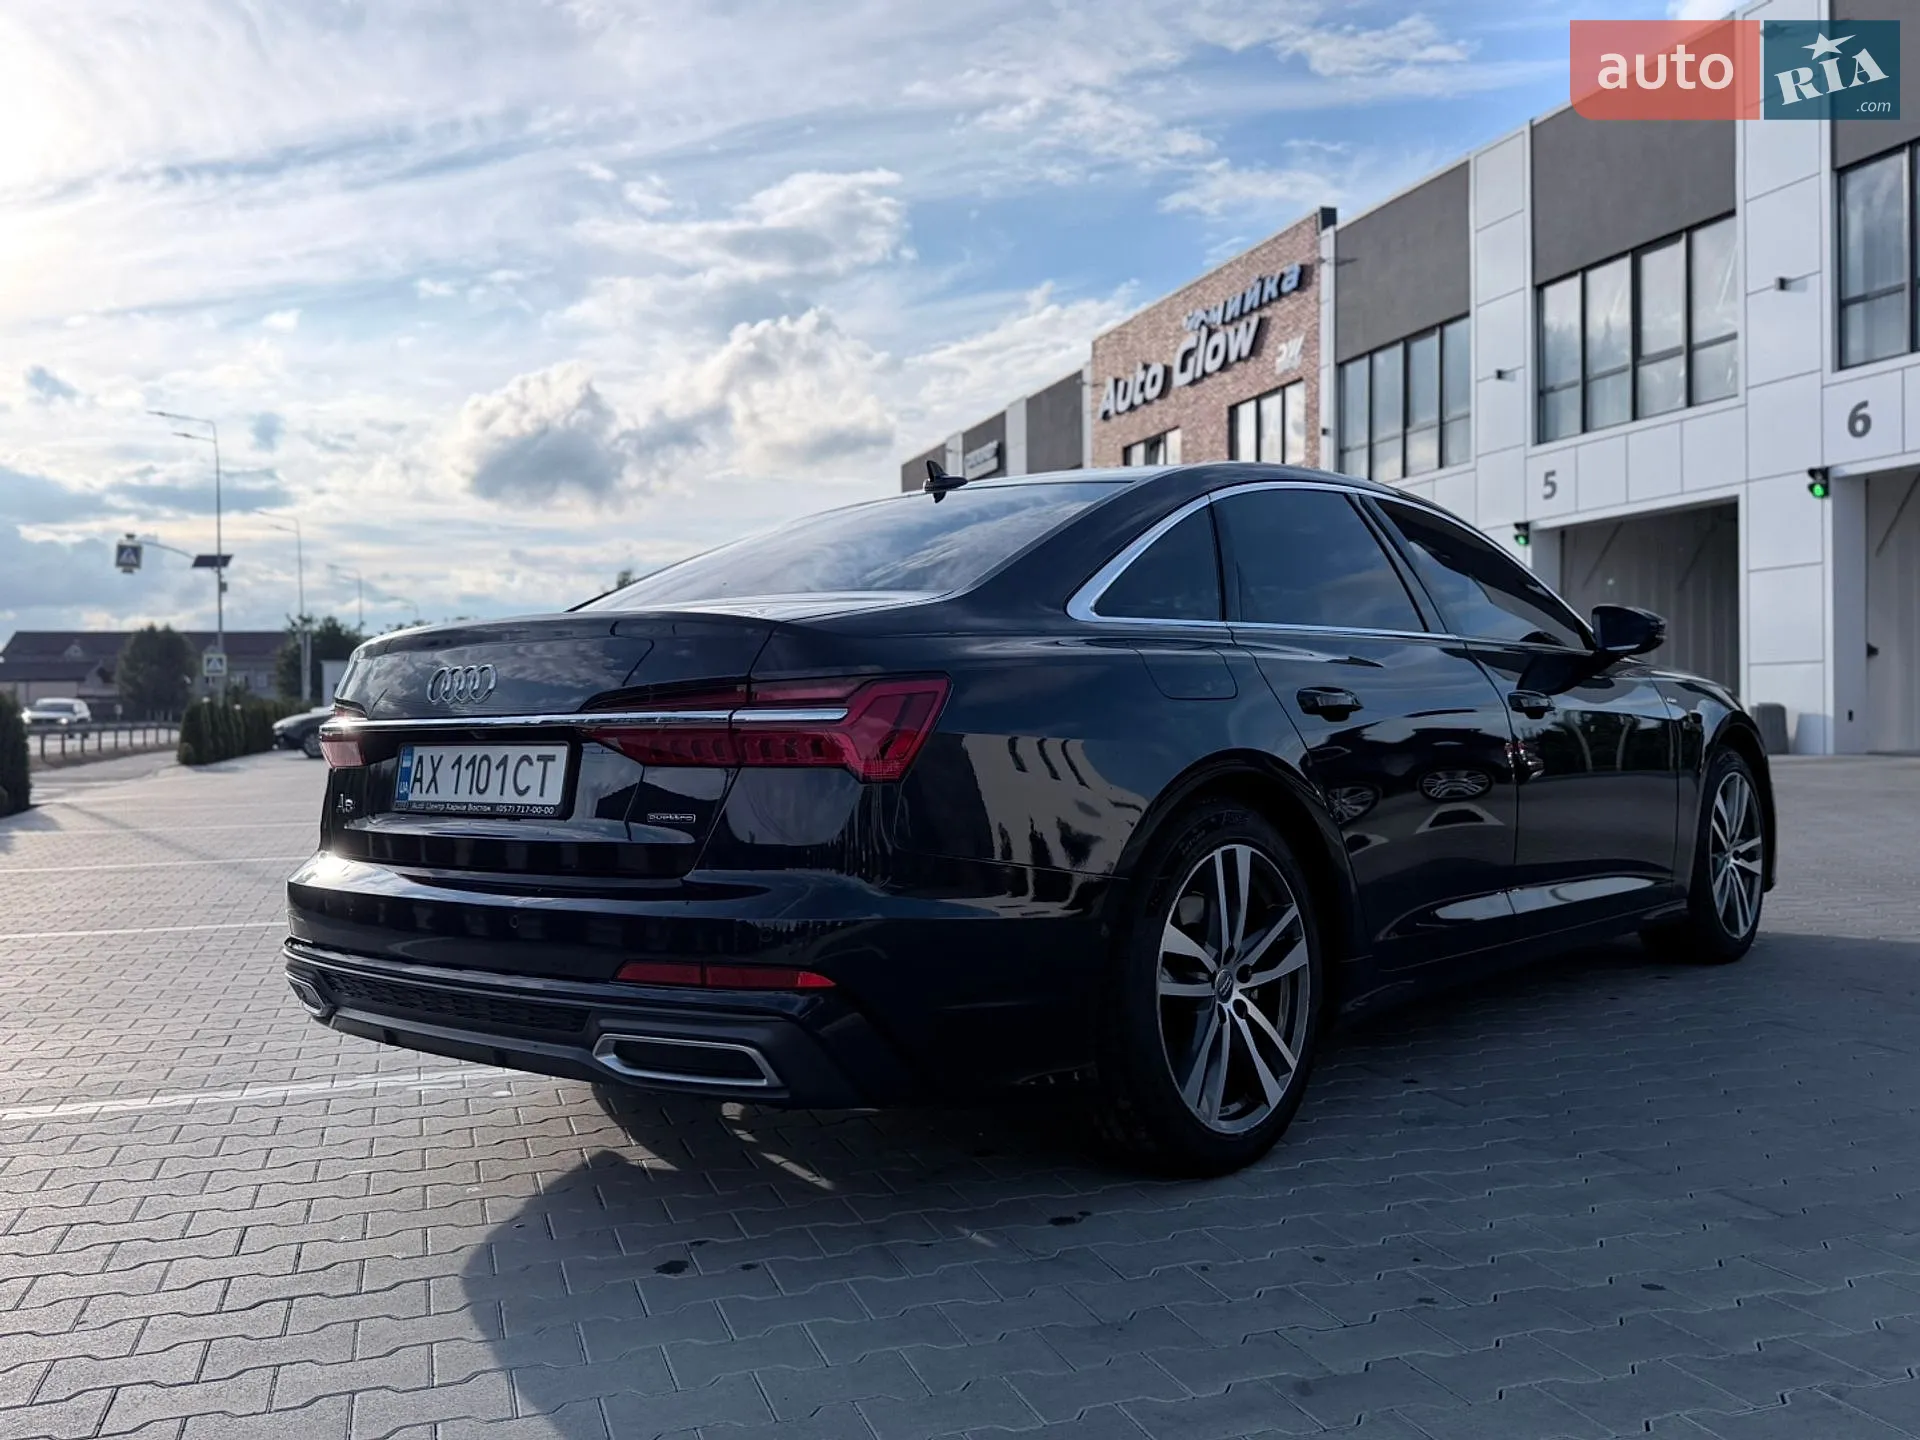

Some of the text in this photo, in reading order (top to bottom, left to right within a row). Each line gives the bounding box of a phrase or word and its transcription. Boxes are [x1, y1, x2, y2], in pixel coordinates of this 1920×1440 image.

[1099, 362, 1164, 421] Auto
[1172, 313, 1260, 388] Glow
[1847, 400, 1872, 438] 6
[1543, 470, 1558, 499] 5
[410, 754, 557, 798] AX 1101 CT
[516, 806, 555, 815] 717-00-00
